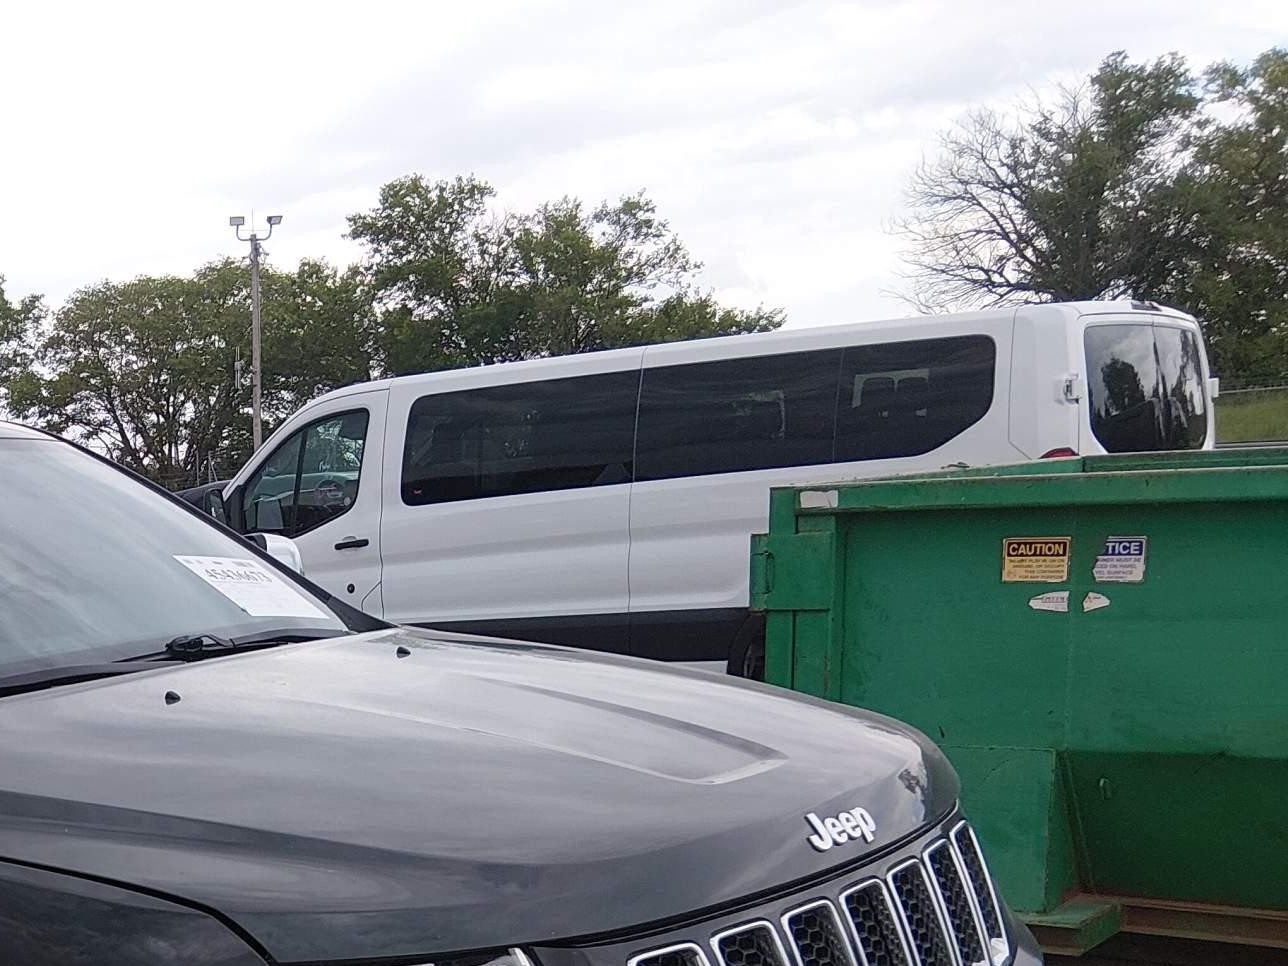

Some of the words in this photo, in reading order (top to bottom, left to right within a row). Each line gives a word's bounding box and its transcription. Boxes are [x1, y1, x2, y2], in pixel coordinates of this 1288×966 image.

[1009, 543, 1064, 555] CAUTION
[1105, 542, 1141, 555] TICE
[804, 807, 876, 852] Jeep
